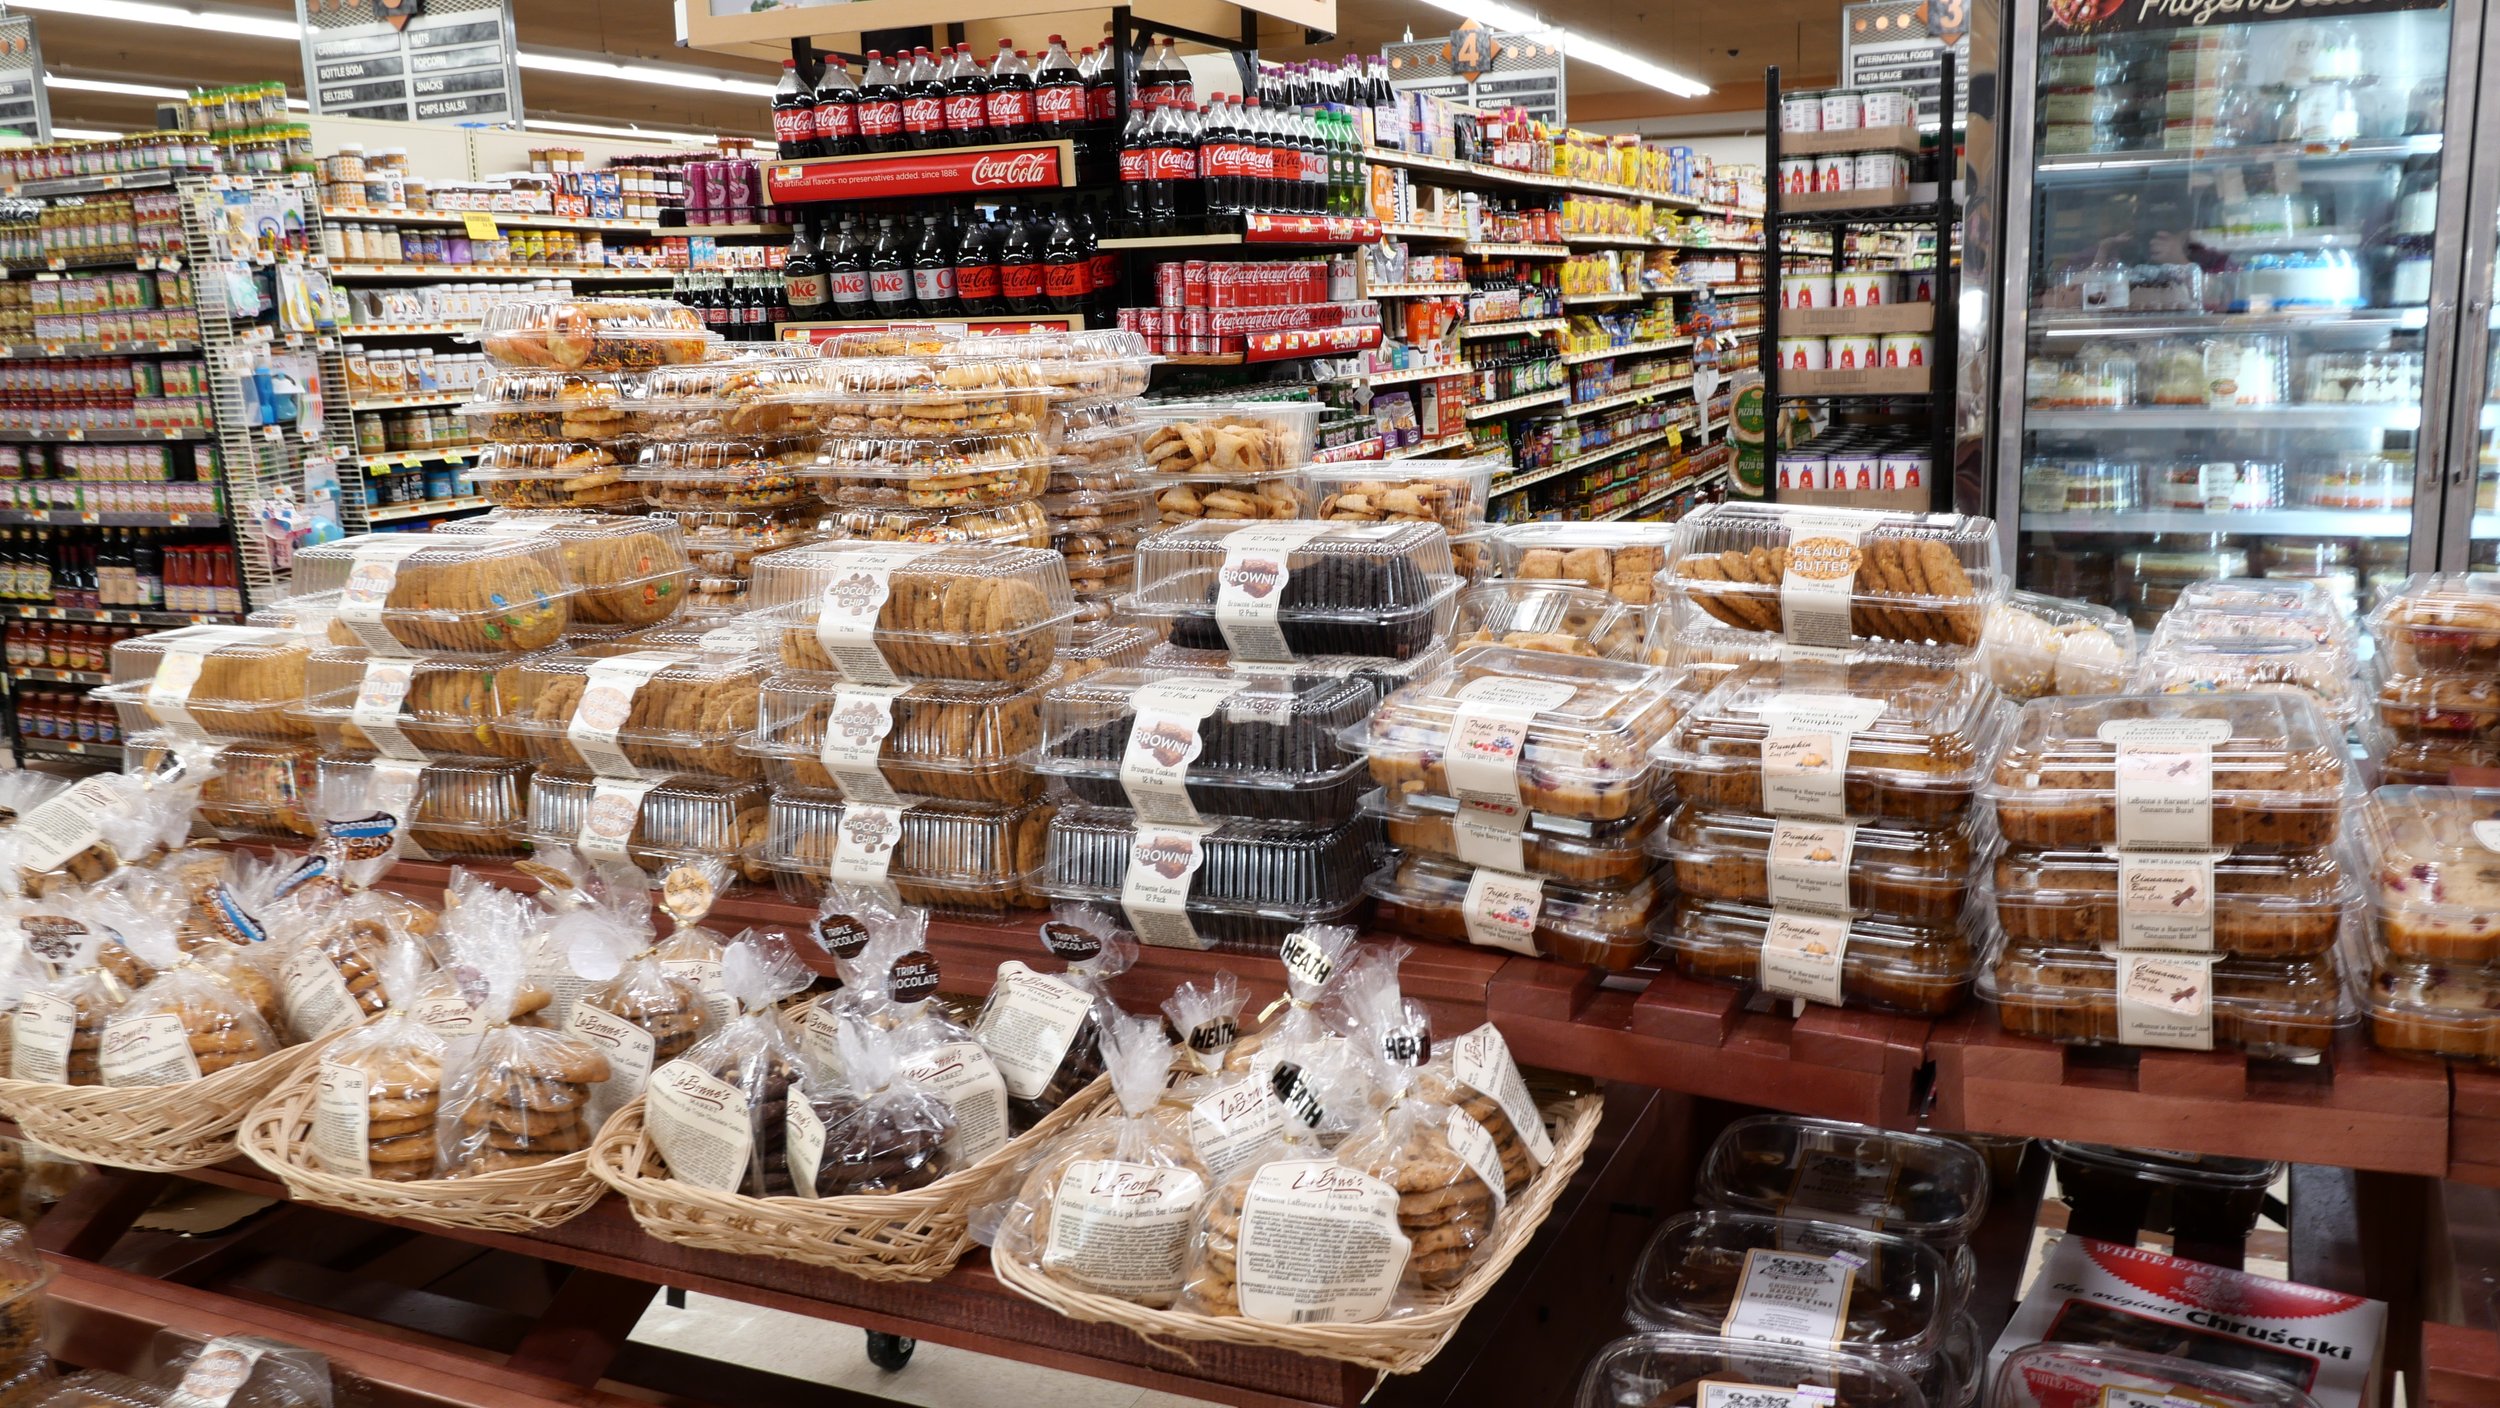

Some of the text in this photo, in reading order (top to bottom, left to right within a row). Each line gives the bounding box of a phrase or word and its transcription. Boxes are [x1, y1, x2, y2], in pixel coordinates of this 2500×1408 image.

[1940, 0, 1963, 28] 3
[1458, 33, 1480, 67] 4
[413, 56, 446, 68] POPCORN
[1858, 50, 1934, 65] INTERNATIONAL FOODS
[320, 66, 364, 79] BOTTLE SODA
[1857, 70, 1902, 82] PASTA SAUCE
[416, 81, 444, 92] SNACKS
[1480, 84, 1492, 92] TEA
[323, 89, 353, 102] SELTZERS
[419, 101, 467, 115] CHIPS & SALSA
[1479, 99, 1511, 108] CREAMERS
[971, 153, 1048, 186] Coca-Cola
[784, 178, 811, 187] artificial
[812, 177, 836, 185] flavors.
[849, 172, 894, 183] preservatives
[895, 171, 919, 180] added.
[921, 170, 939, 178] since
[941, 168, 959, 177] 1886.
[786, 282, 817, 297] oke
[832, 276, 864, 293] oke
[872, 276, 903, 292] oke
[1794, 546, 1852, 557] PEANUT
[1794, 560, 1850, 572] BUTTER
[841, 598, 865, 607] CHIP
[1227, 600, 1272, 608] Brownie Cookies
[1245, 609, 1258, 617] Pack
[1173, 692, 1197, 700] Pack
[846, 727, 870, 737] CHIP
[1470, 720, 1521, 736] Triple Berry
[1768, 740, 1811, 751] Pumpkin
[1130, 764, 1177, 778] Brownie Cookies
[1149, 776, 1163, 785] Pack
[1794, 794, 1820, 803] Pumpkin
[855, 834, 877, 844] CHIP
[1781, 831, 1824, 842] Pumpkin
[2130, 873, 2185, 884] Cinnamon
[1134, 882, 1181, 896] Brownie Cookies
[1796, 883, 1821, 892] Pumpkin
[2131, 883, 2156, 891] Burst
[1152, 894, 1166, 903] Pack
[1487, 886, 1536, 905] Triple Berry
[825, 925, 852, 937] TRIPLE
[1778, 922, 1820, 936] Pumpkin
[824, 932, 868, 948] HOCOLATE
[1053, 931, 1081, 942] TRIPLE
[1283, 935, 1333, 984] HEATH
[895, 964, 926, 976] TRIPLE
[2135, 964, 2189, 982] Cinnamon
[2134, 973, 2159, 985] Burst
[1194, 1021, 1237, 1049] HEATH
[1272, 1064, 1324, 1129] HEATH
[2097, 1242, 2344, 1305] WHITE EAGLE BAKERY
[1750, 1292, 1833, 1309] BISCOTTINI
[2053, 1282, 2353, 1361] the original Chruściki
